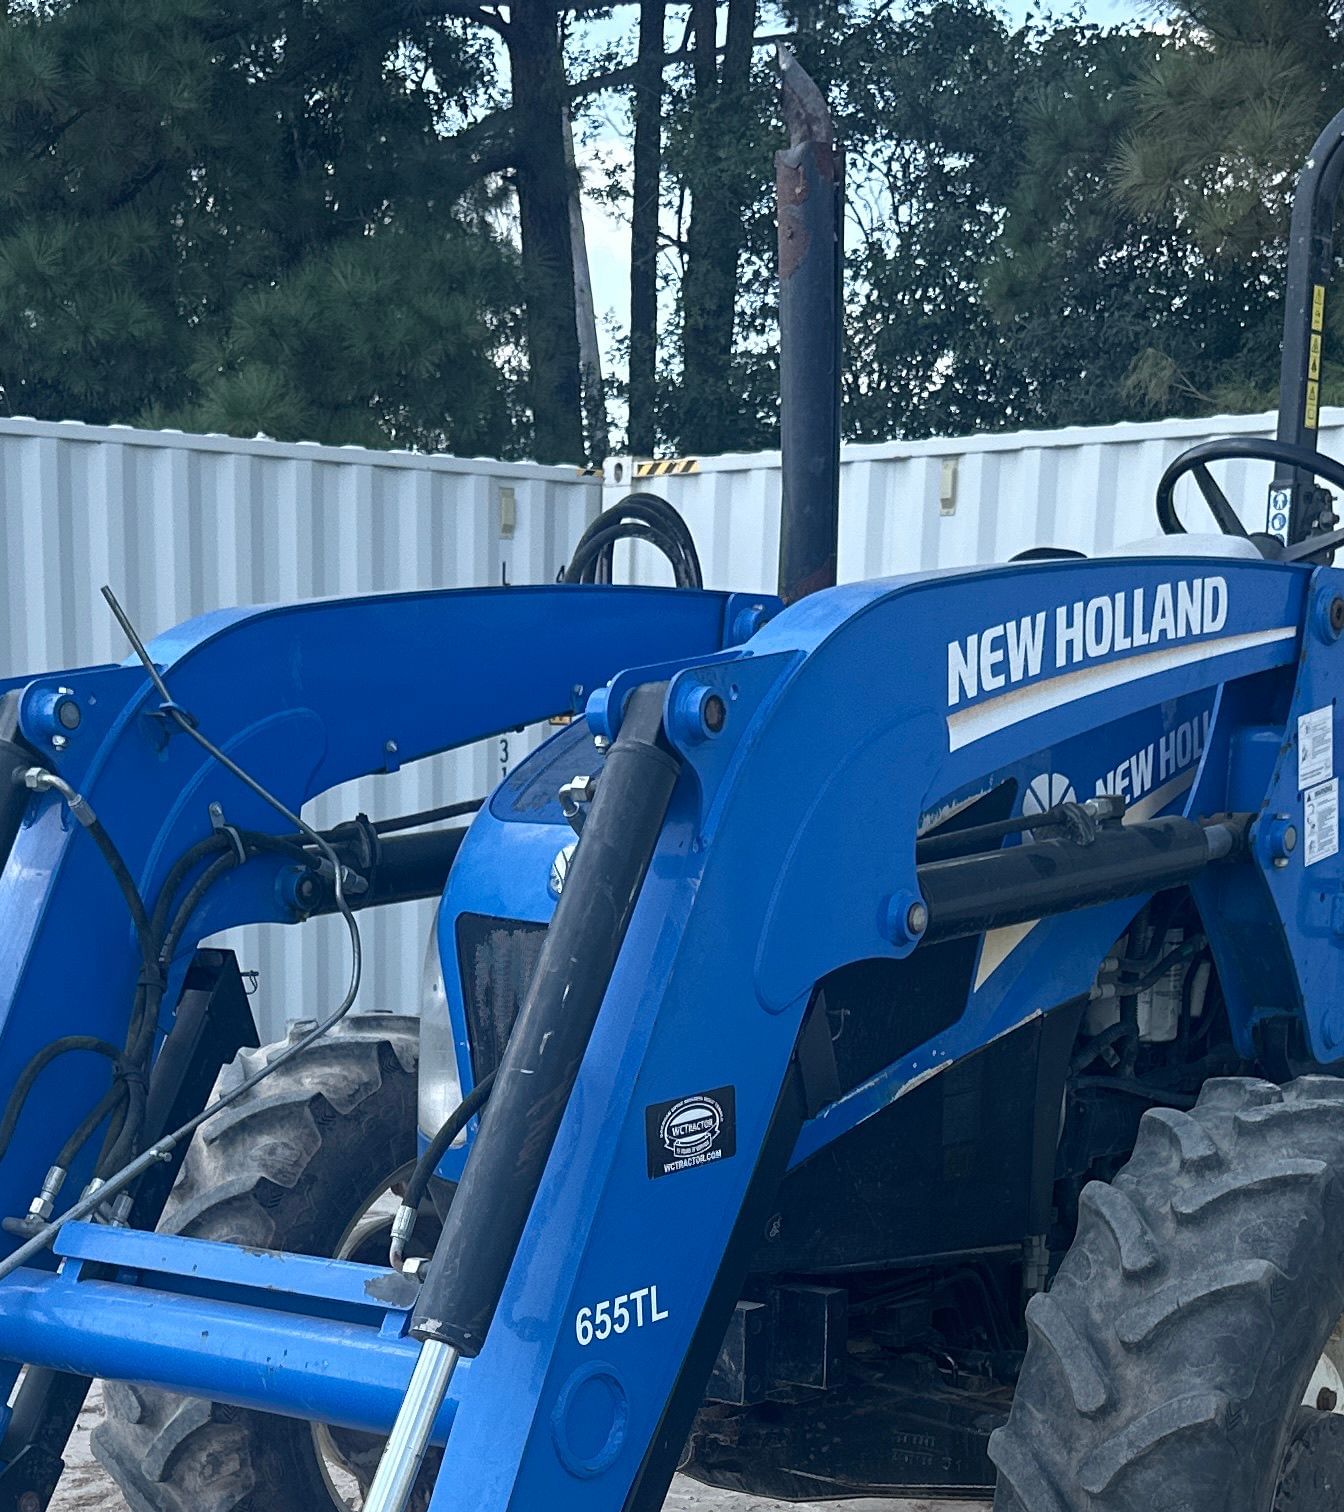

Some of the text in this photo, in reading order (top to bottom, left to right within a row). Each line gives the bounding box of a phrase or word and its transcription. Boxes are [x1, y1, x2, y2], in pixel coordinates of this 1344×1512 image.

[948, 576, 1228, 706] NEW HOLLAND
[663, 1149, 722, 1172] WCTRACTOR.COM
[575, 1285, 669, 1346] 655TL
